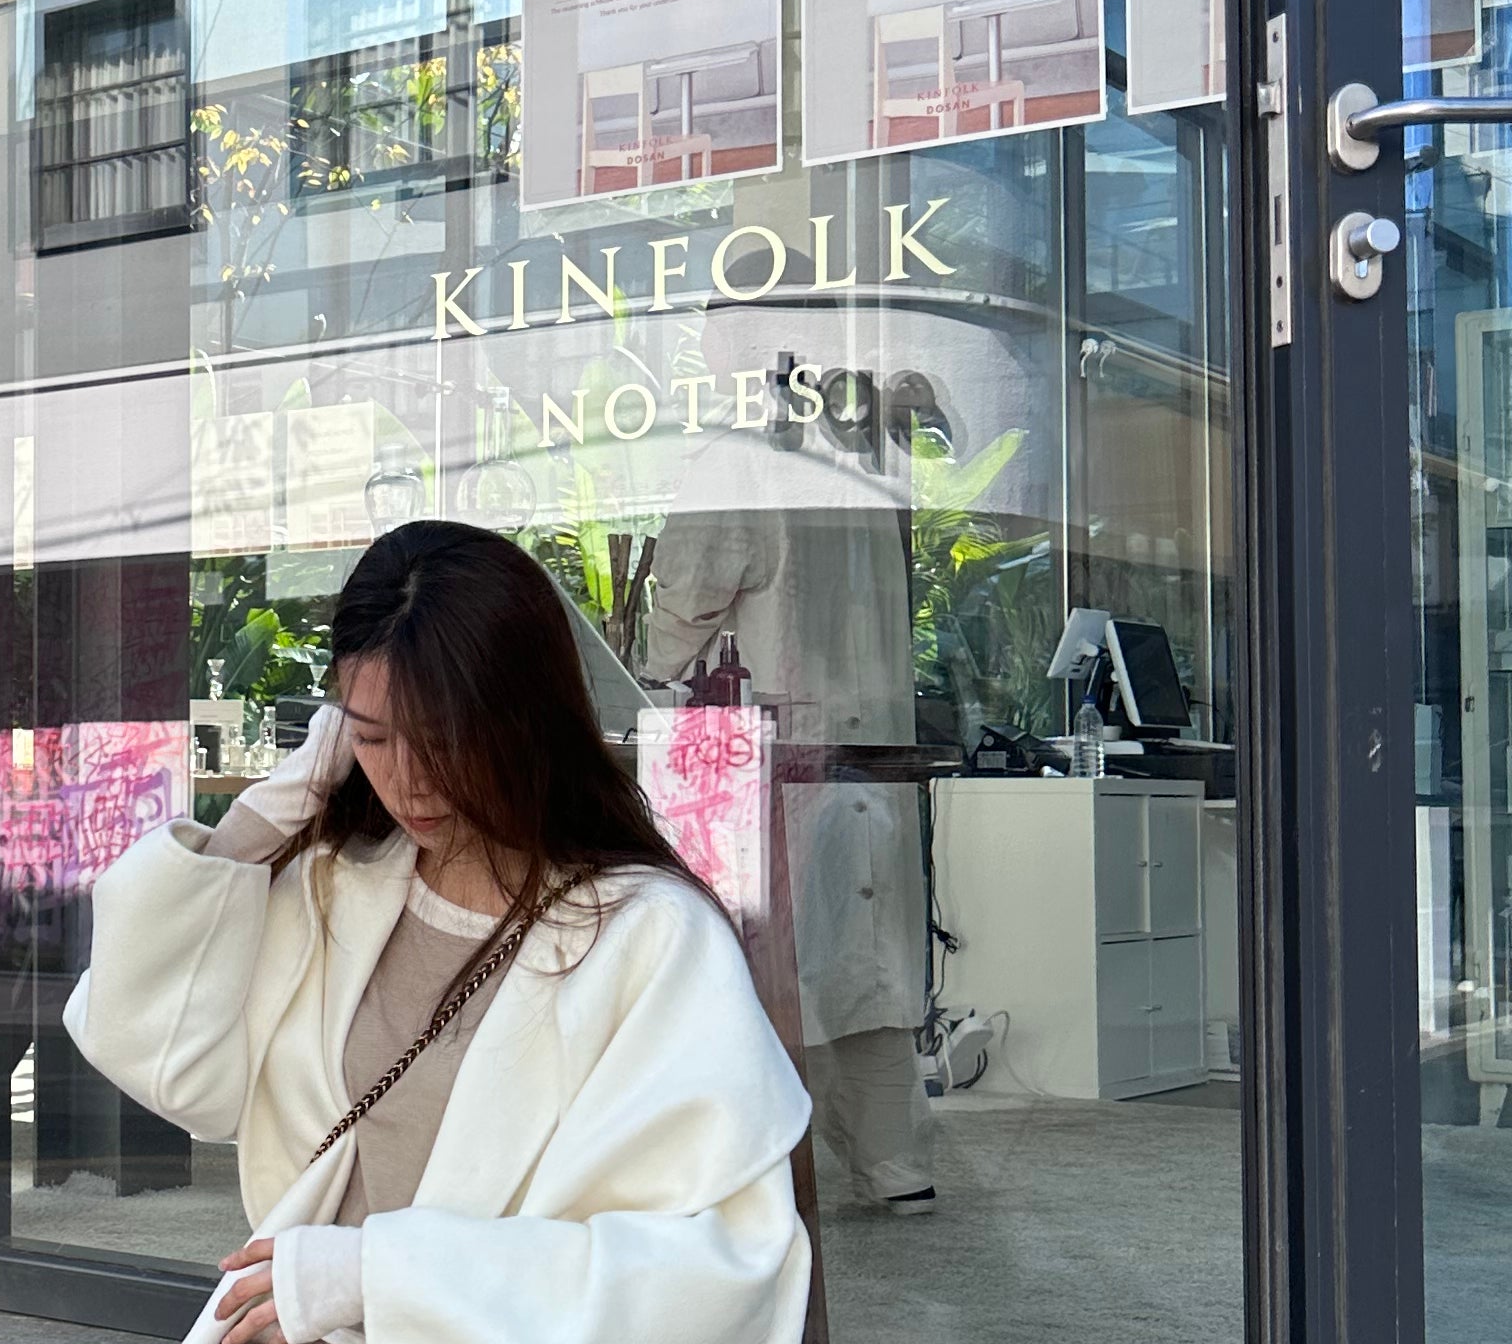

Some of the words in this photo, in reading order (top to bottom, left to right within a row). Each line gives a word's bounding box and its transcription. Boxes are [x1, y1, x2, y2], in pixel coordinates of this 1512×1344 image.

[917, 83, 980, 102] KINFOLK
[926, 99, 971, 116] DOSAN
[618, 134, 673, 153] KINFOLK
[626, 151, 665, 166] DOSAN
[431, 197, 958, 341] KINFOLK
[537, 363, 829, 448] NOTES
